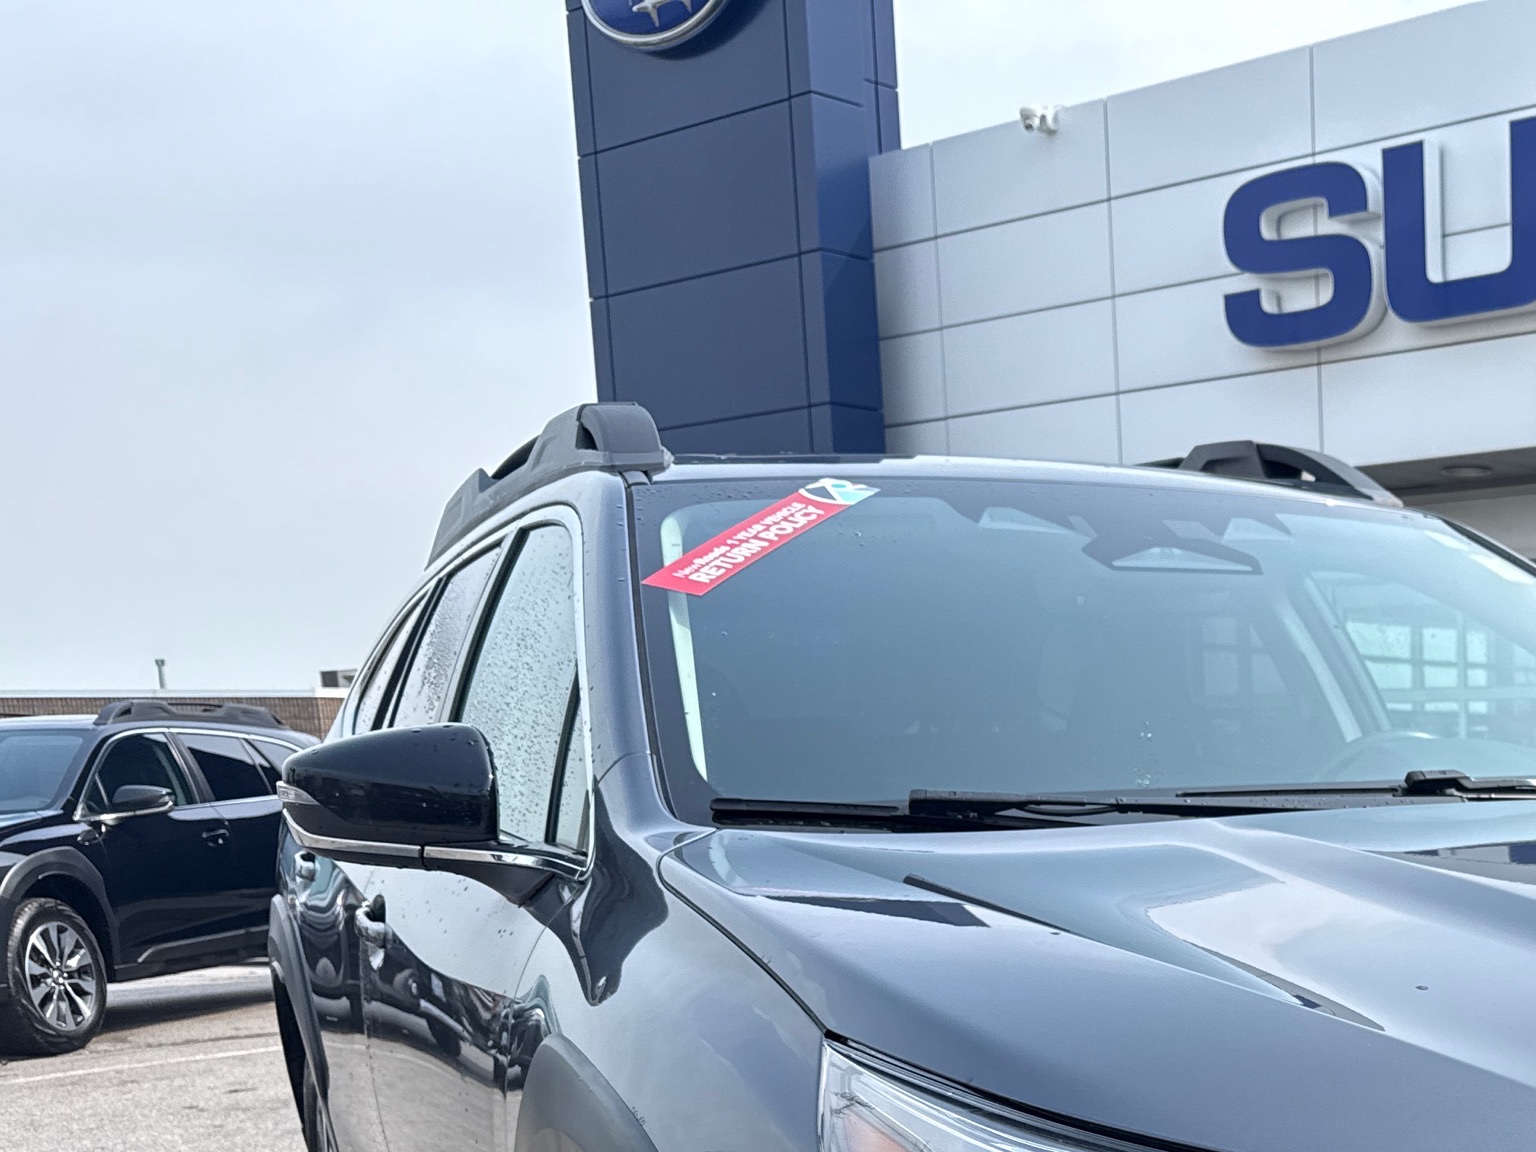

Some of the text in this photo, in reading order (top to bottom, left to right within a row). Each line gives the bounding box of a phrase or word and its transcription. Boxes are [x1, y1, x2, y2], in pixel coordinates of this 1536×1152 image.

[688, 505, 825, 583] RETURN POLICY
[732, 523, 767, 541] YEAR
[760, 501, 806, 527] VEHICLE
